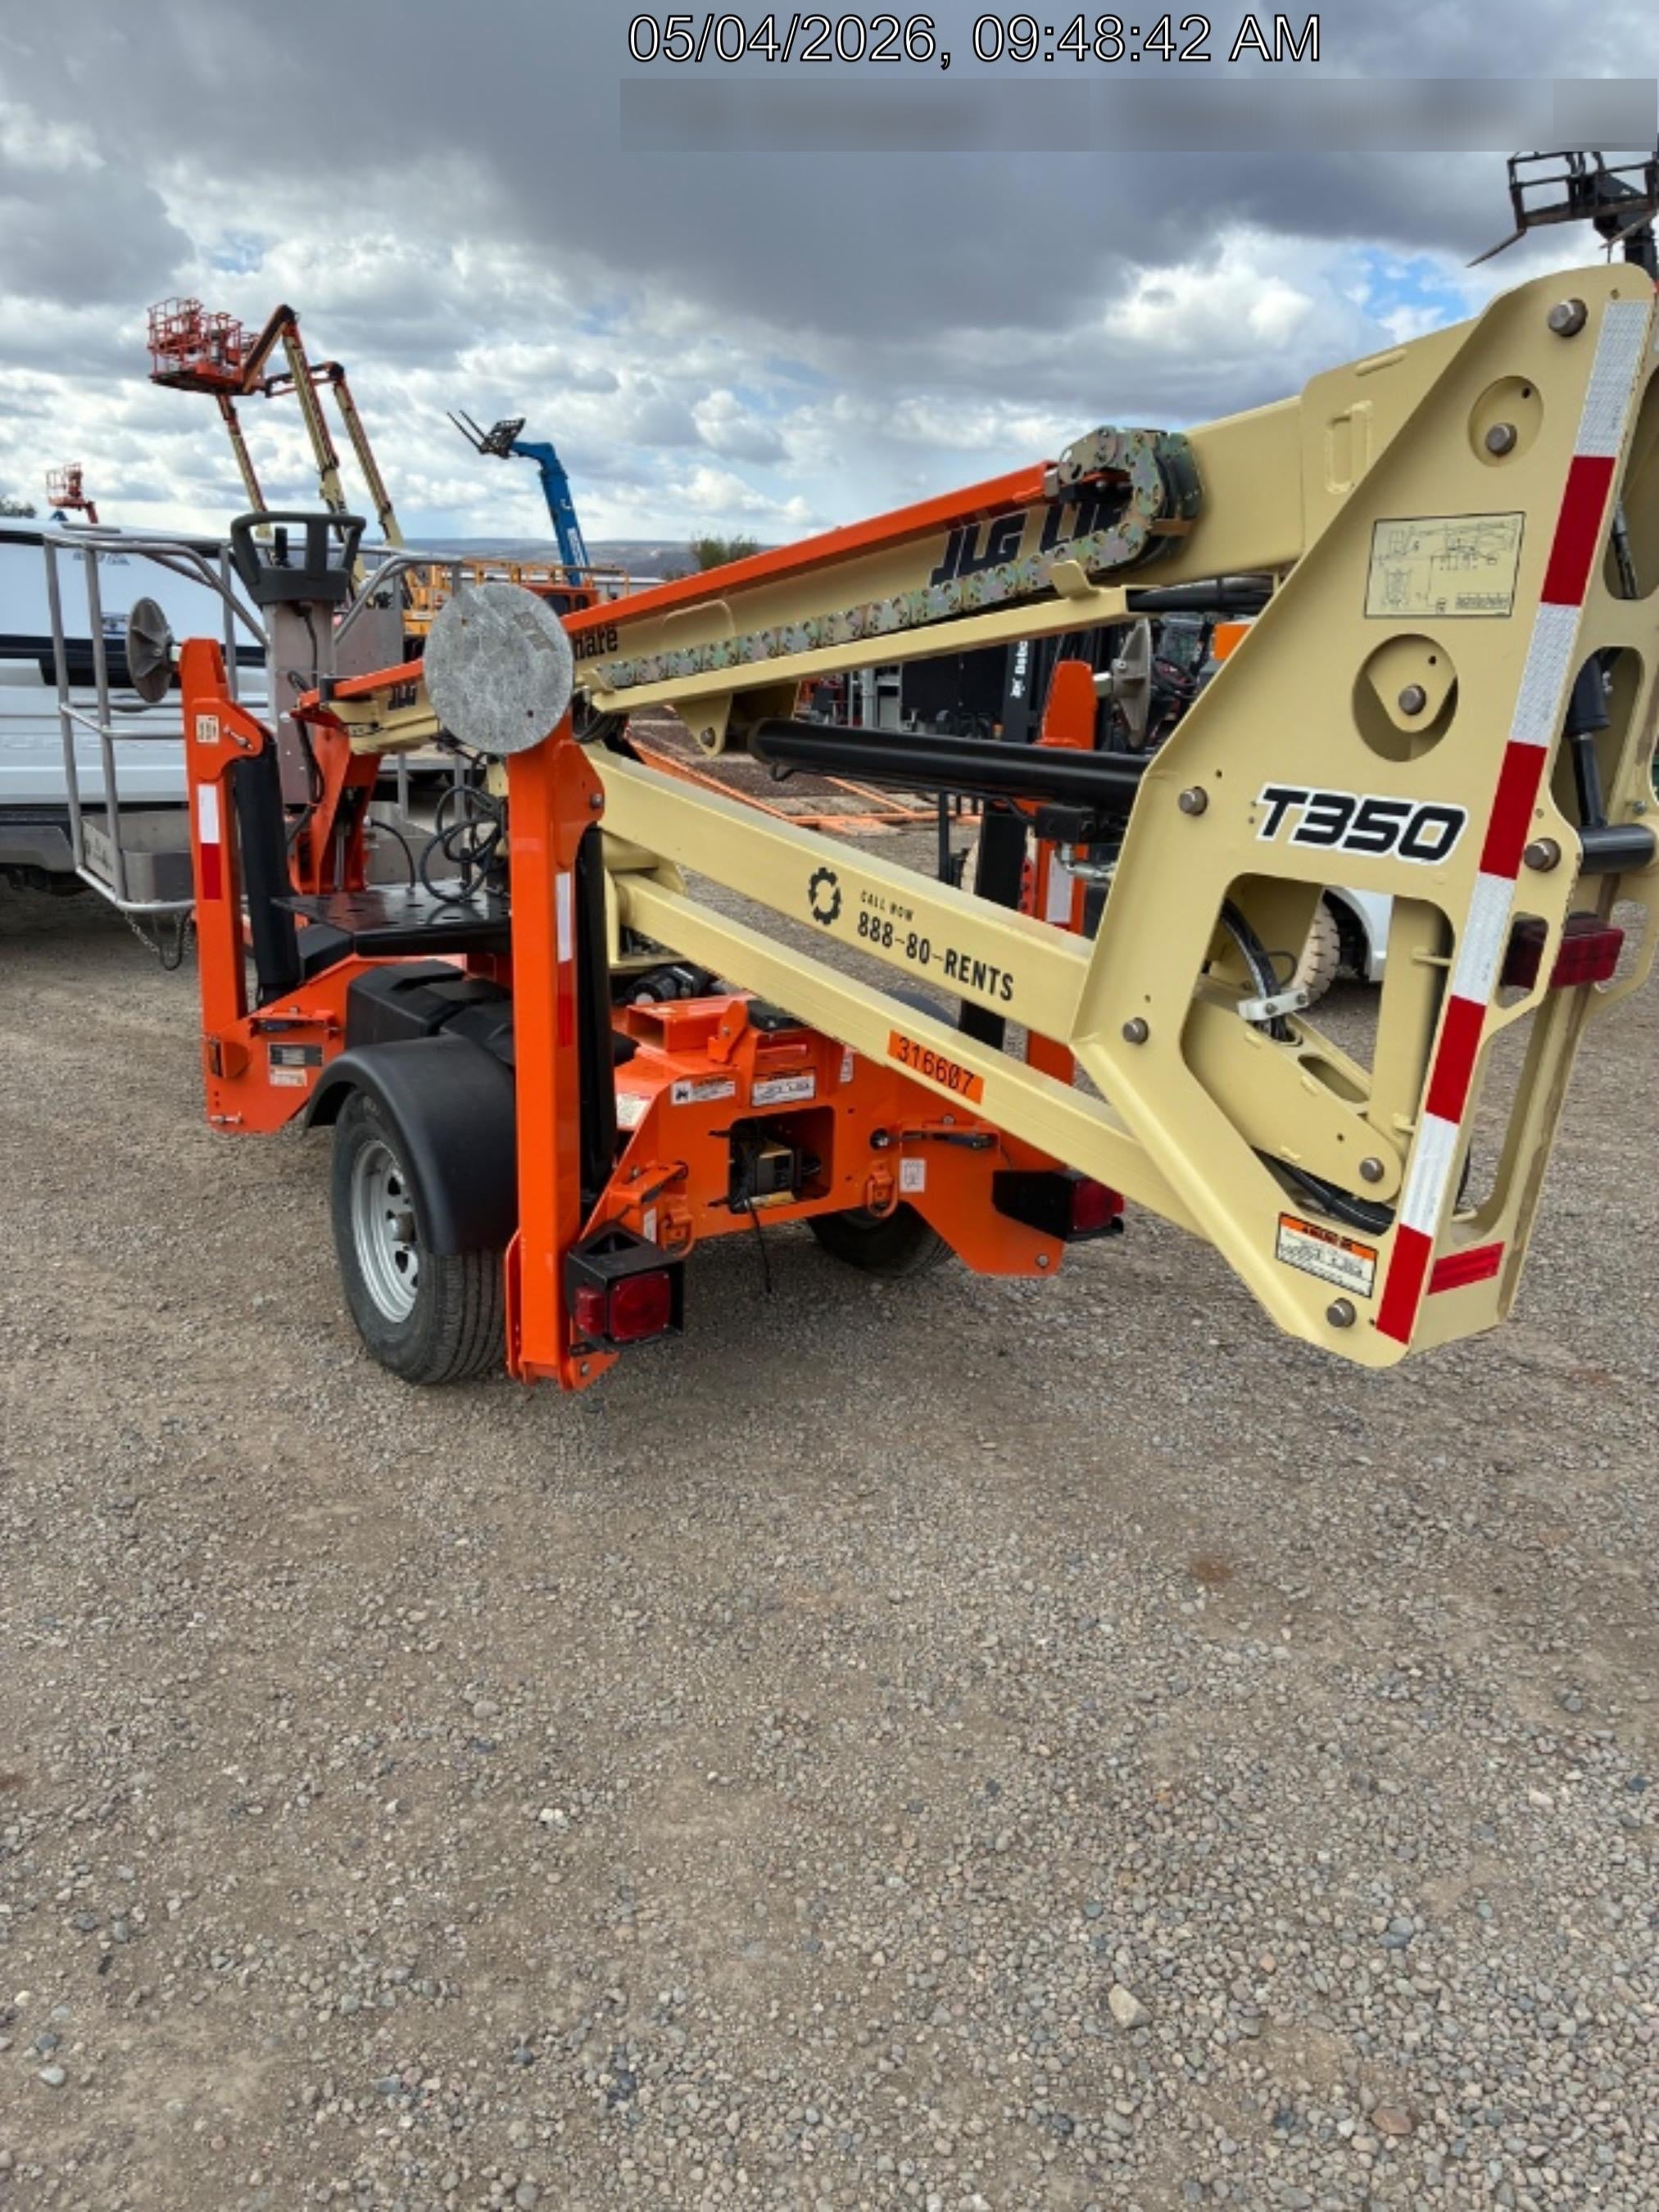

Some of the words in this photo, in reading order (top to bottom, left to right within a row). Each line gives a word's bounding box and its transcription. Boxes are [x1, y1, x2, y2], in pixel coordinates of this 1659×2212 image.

[930, 511, 1027, 587] JLG
[1262, 787, 1466, 862] T350
[857, 911, 1014, 1002] 888-80-RENTS
[898, 1036, 976, 1095] 316607
